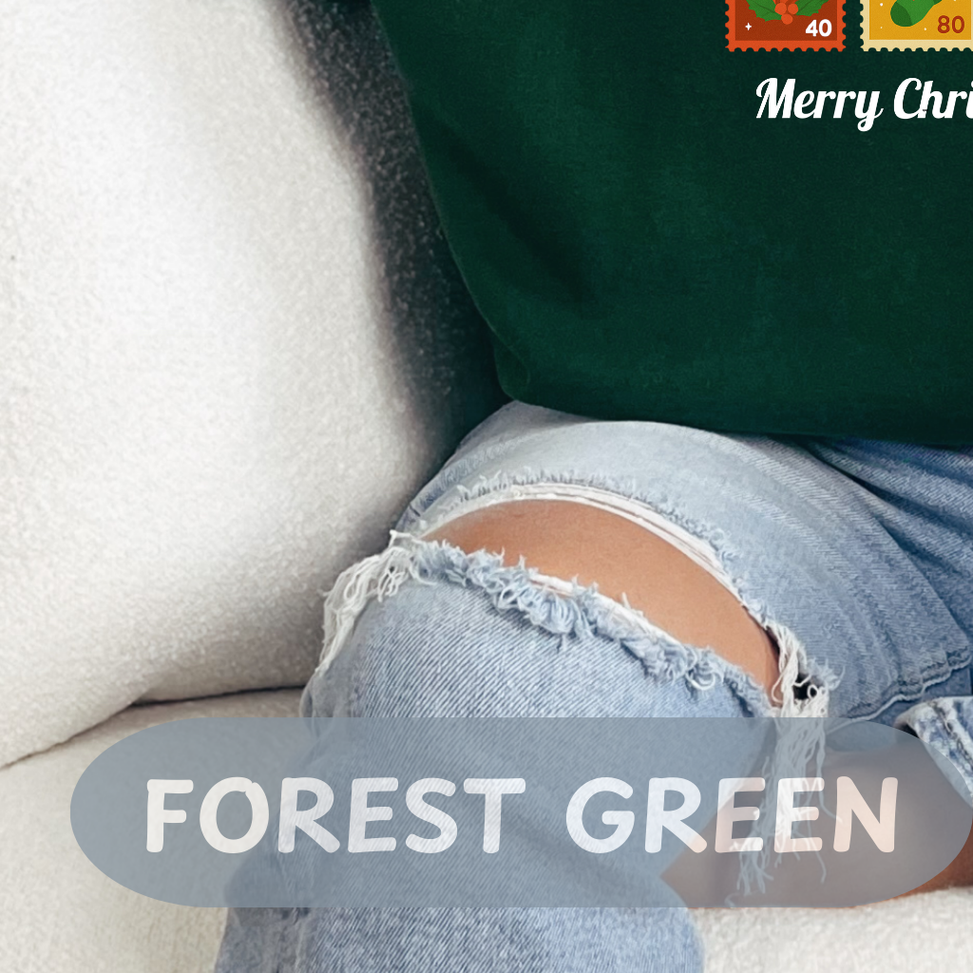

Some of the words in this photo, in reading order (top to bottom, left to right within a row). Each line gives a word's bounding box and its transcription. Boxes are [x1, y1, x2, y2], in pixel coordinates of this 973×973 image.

[805, 19, 832, 37] 40
[937, 15, 965, 34] 80
[756, 78, 884, 131] Merry
